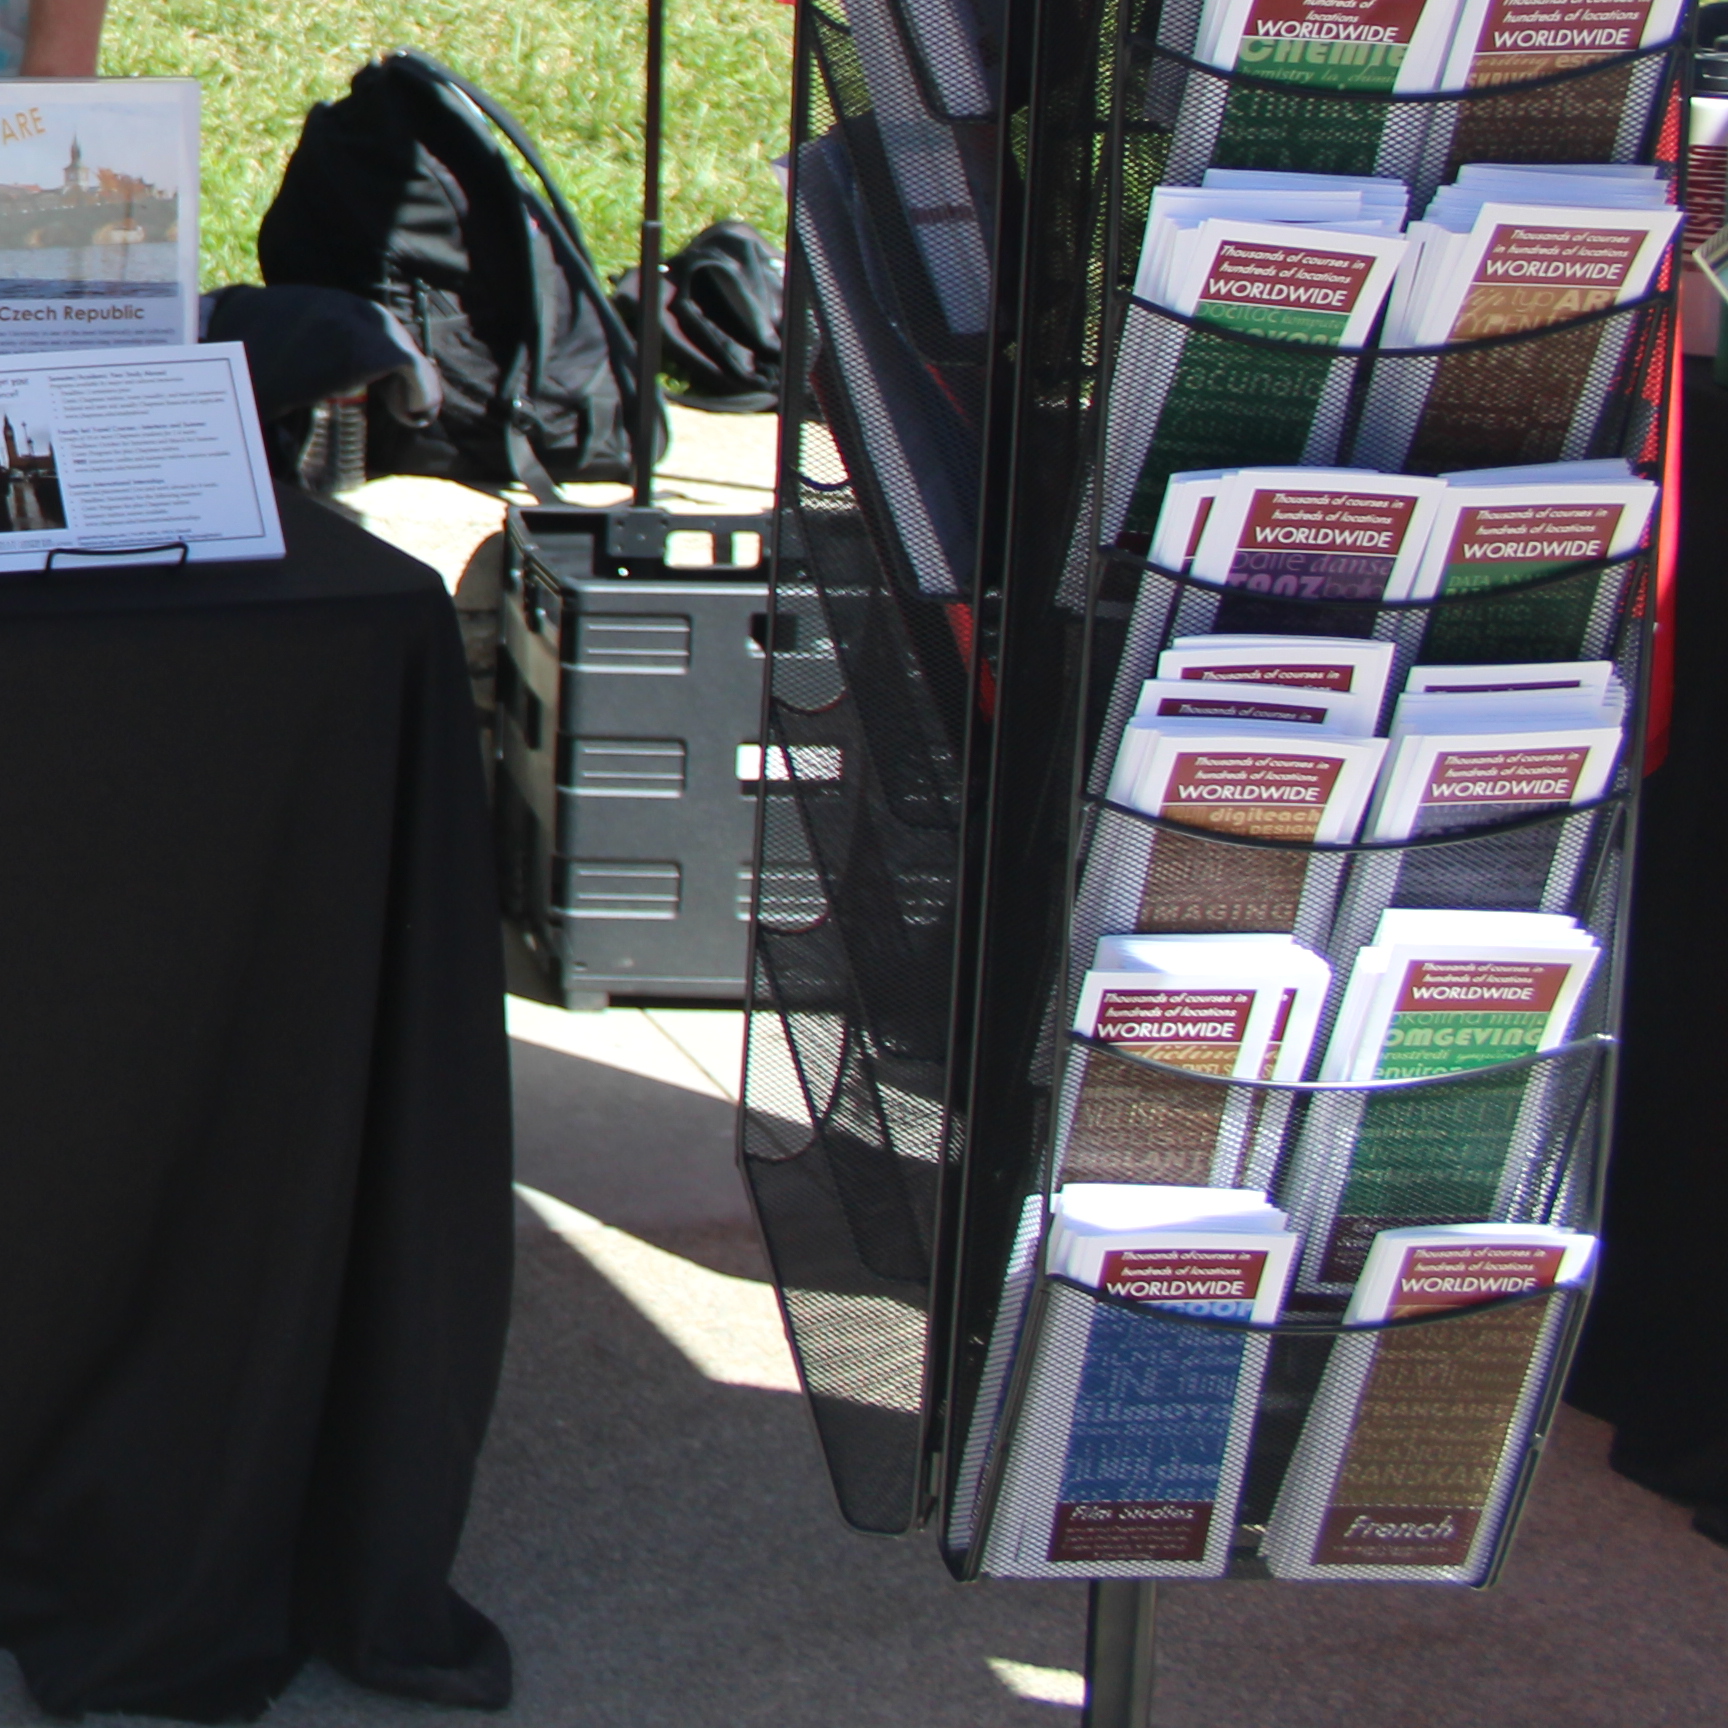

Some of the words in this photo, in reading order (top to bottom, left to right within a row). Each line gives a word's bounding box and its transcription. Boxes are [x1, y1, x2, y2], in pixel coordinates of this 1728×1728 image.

[1257, 20, 1399, 42] WORLDWIDE
[1494, 28, 1631, 47] WORLDWIDE
[1486, 260, 1623, 280] WORLDWIDE
[1209, 278, 1348, 306] WORLDWIDE
[64, 305, 145, 322] Republic
[11, 377, 29, 387] your
[1255, 526, 1393, 548] WORLDWIDE
[1463, 540, 1602, 559] WORLDWIDE
[1178, 784, 1321, 801] WORLDWIDE
[1431, 779, 1570, 797] WORLDWIDE
[1412, 986, 1535, 1000] WORLDWIDE
[1097, 1022, 1236, 1038] WORLDWIDE
[1106, 1281, 1244, 1296] WORLDWIDE
[1344, 1514, 1454, 1542] French
